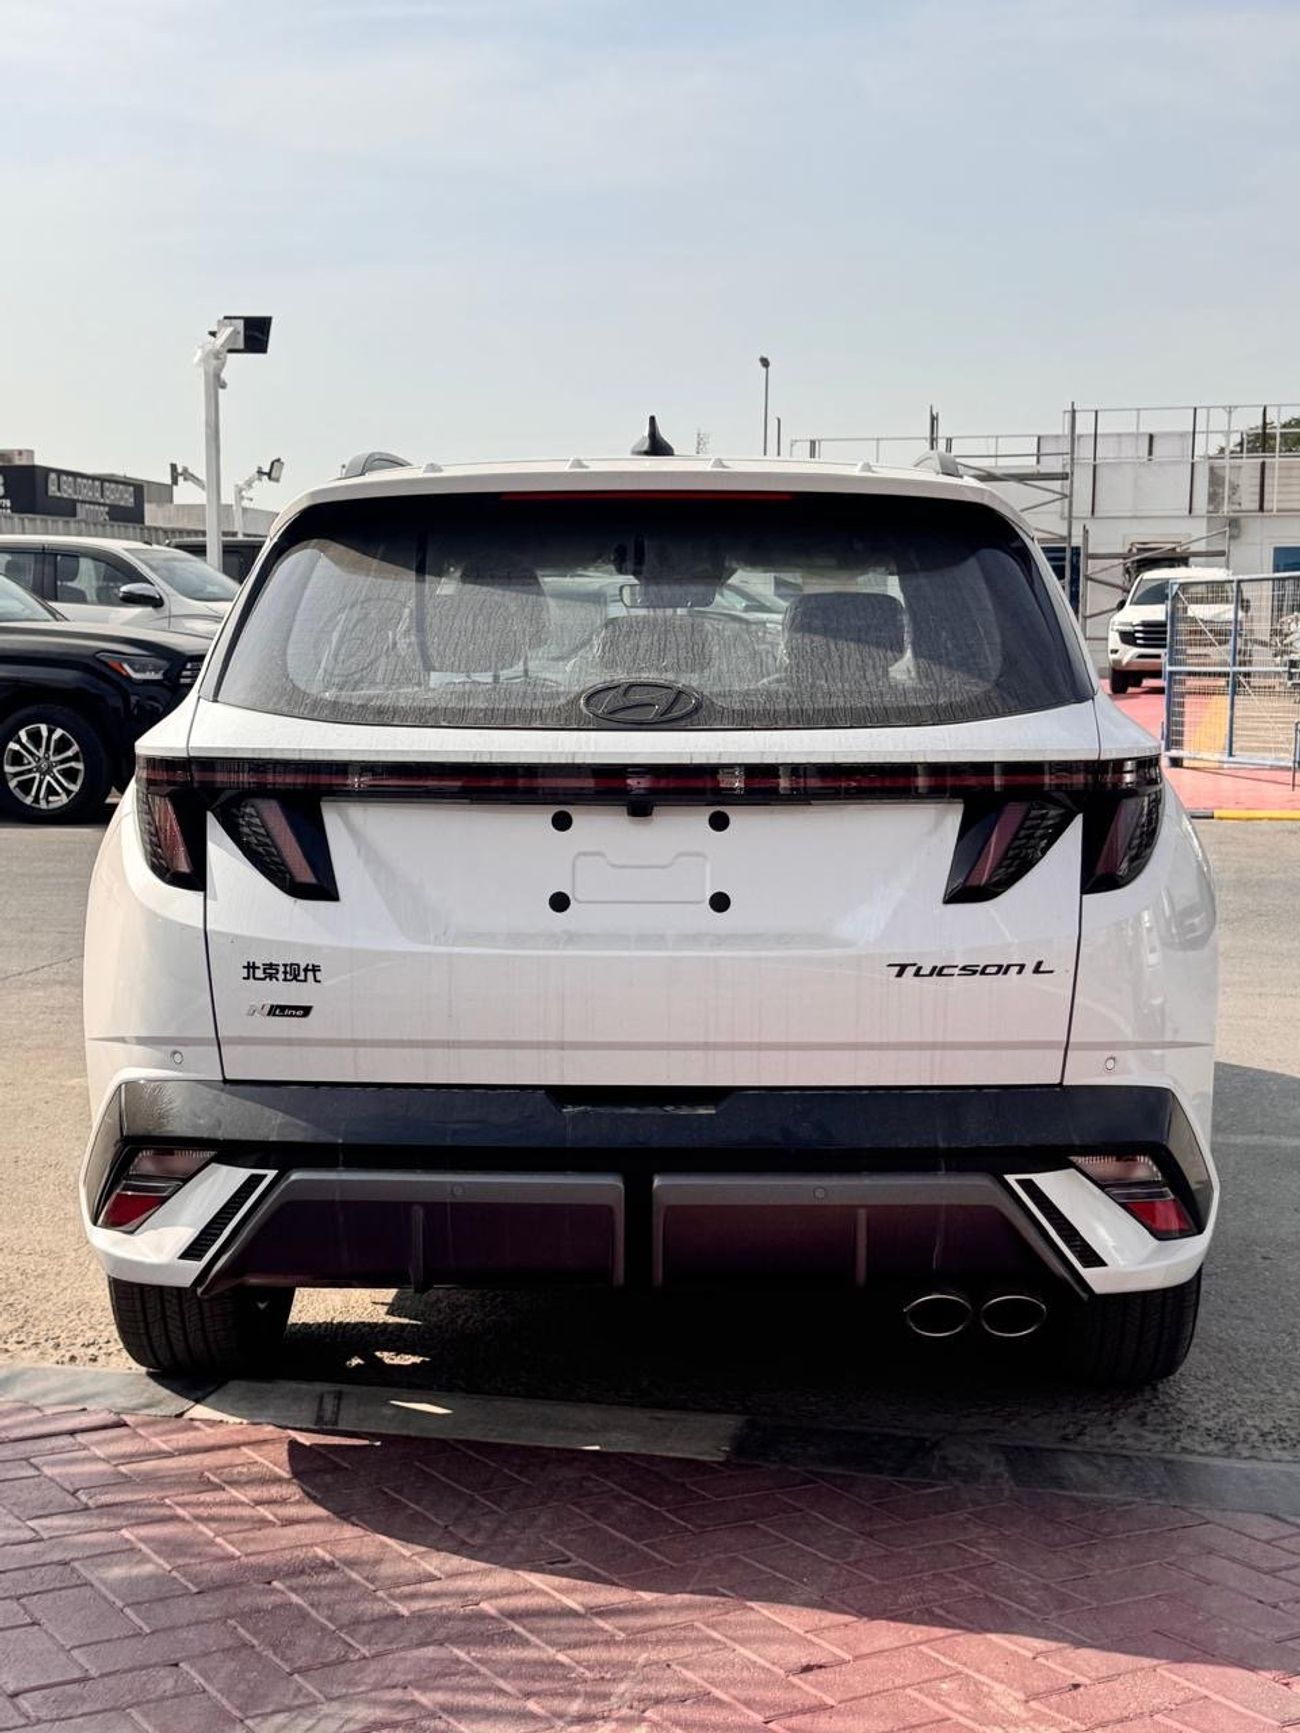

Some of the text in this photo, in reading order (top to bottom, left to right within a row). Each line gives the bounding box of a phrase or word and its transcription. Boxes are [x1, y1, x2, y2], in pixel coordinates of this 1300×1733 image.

[242, 961, 322, 983] 北京现代
[1032, 959, 1055, 975] L
[275, 1008, 305, 1016] Line
